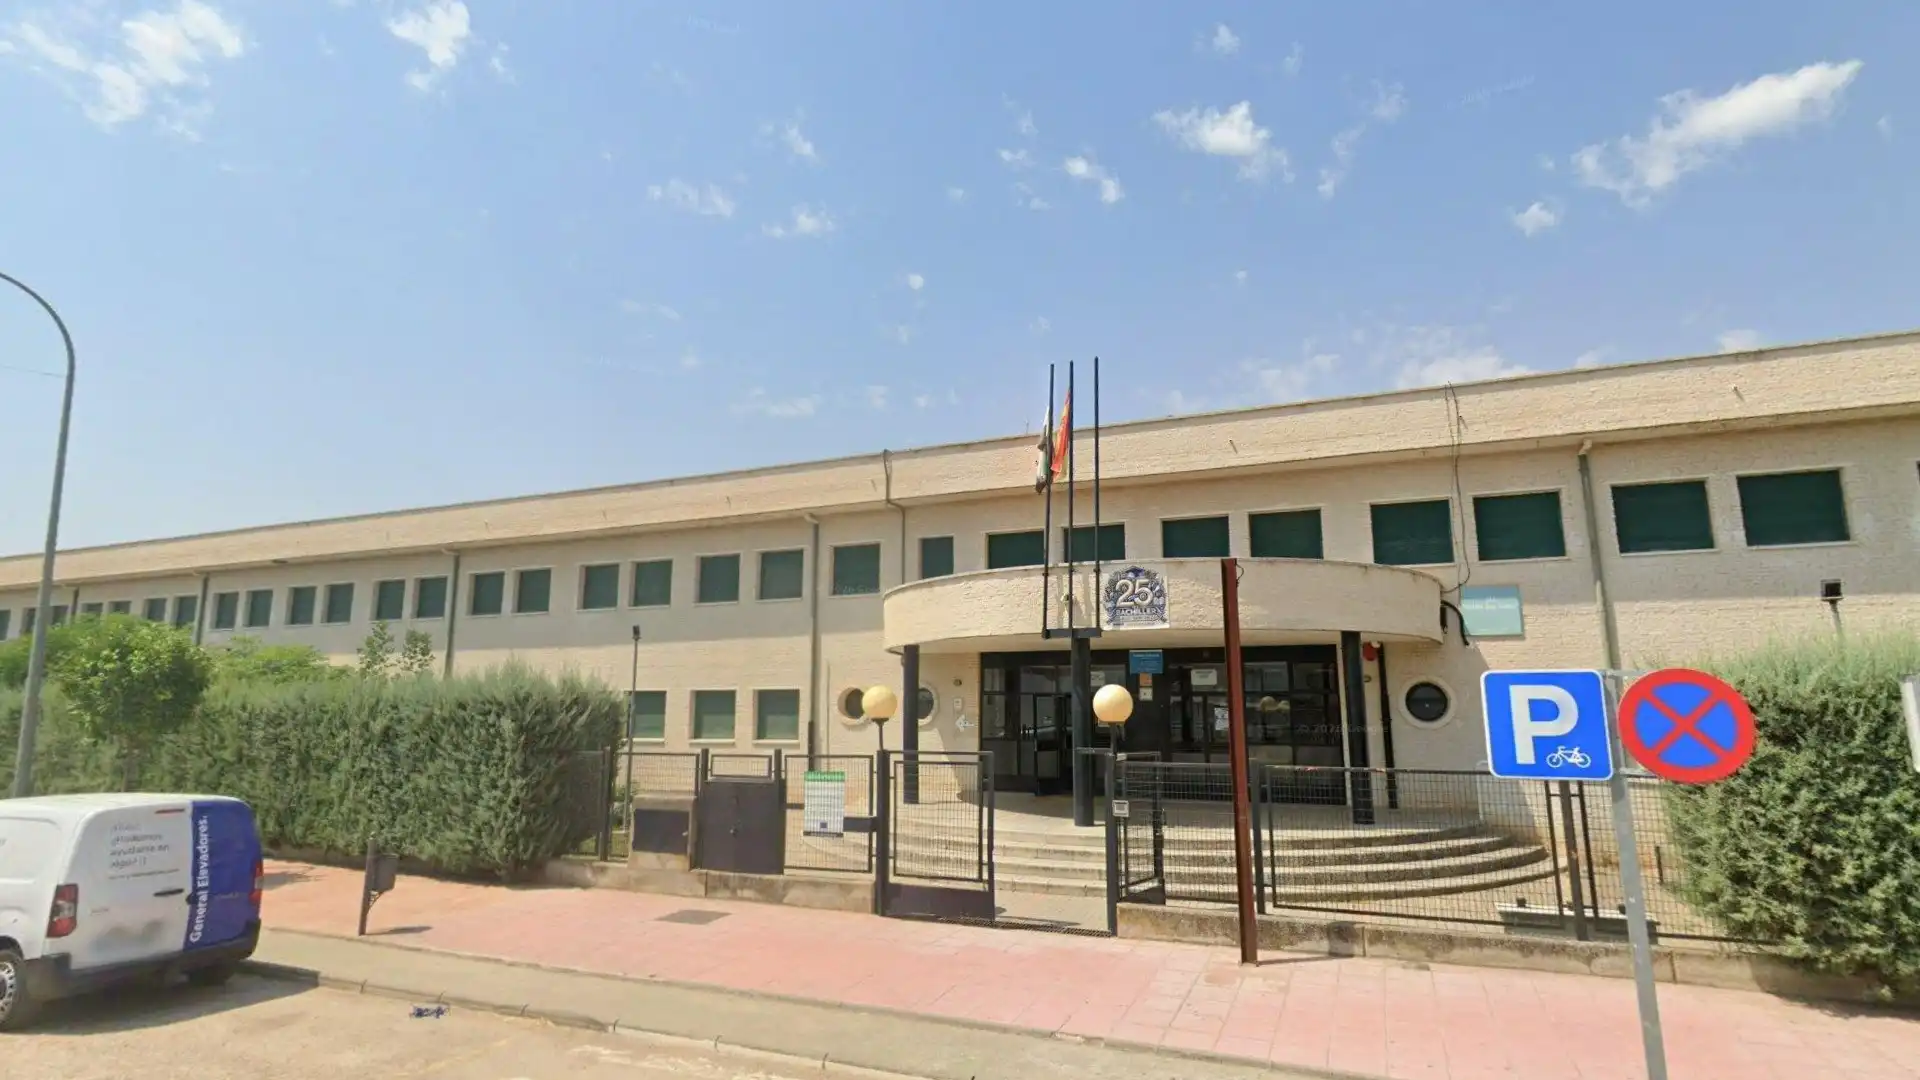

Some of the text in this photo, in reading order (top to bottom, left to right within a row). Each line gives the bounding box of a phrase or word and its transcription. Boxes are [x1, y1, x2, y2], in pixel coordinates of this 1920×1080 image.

[1115, 579, 1153, 607] 25
[1508, 684, 1579, 765] P
[189, 890, 208, 943] General
